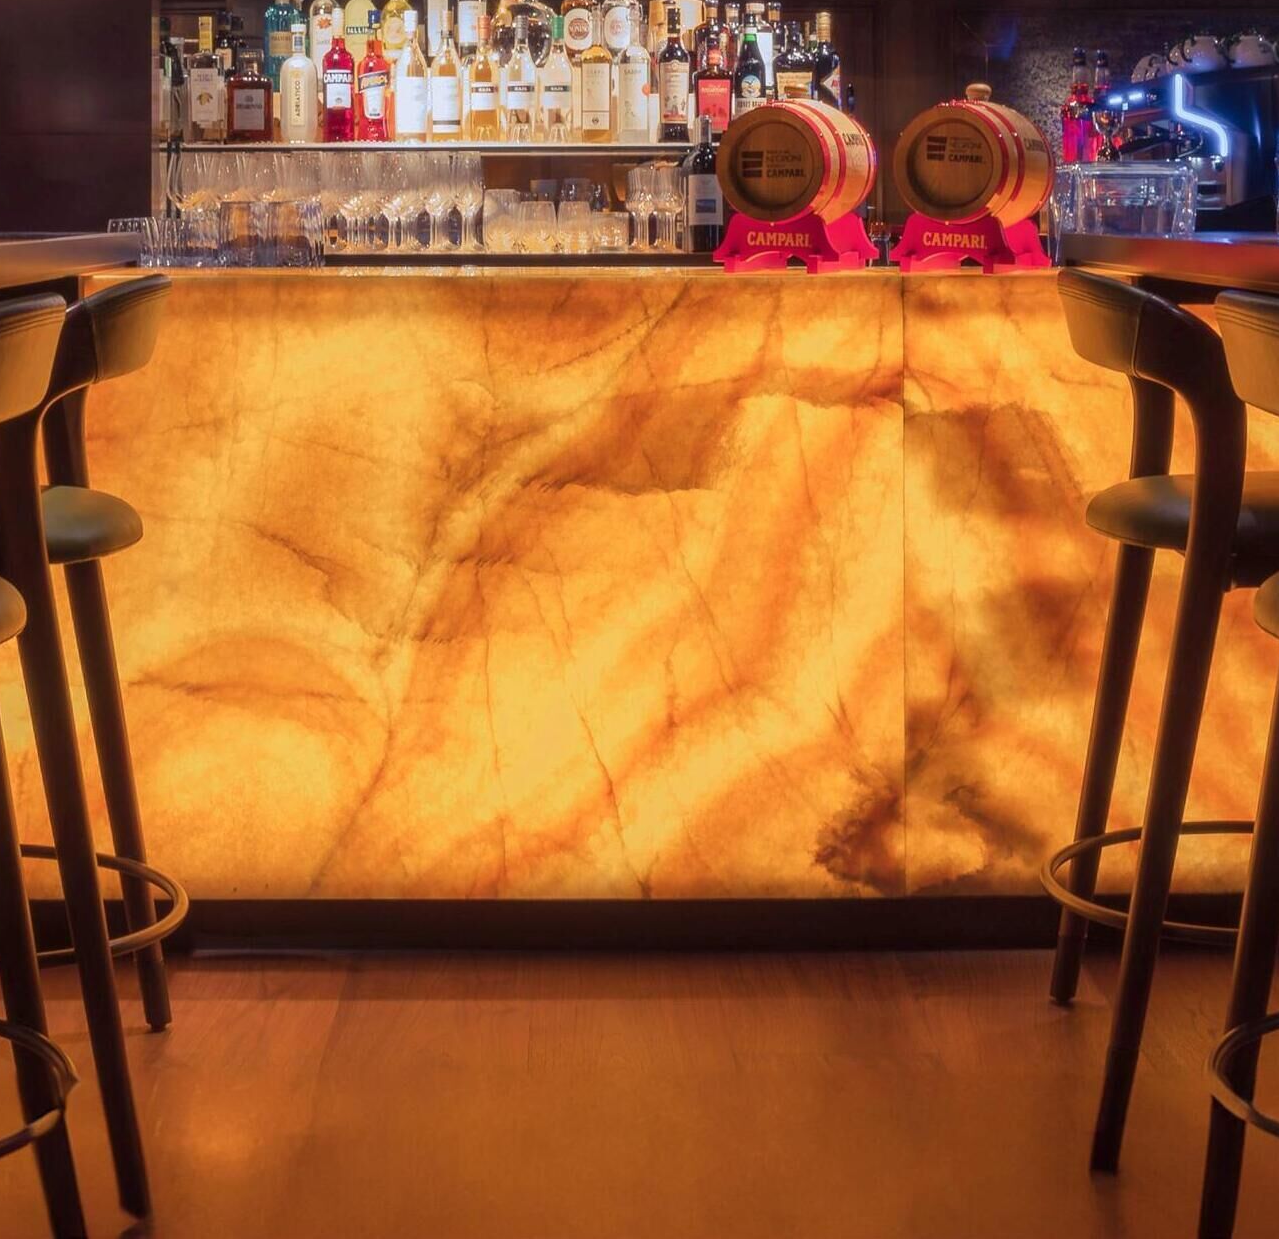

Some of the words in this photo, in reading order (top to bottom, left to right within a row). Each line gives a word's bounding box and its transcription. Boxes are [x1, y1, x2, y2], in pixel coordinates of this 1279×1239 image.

[948, 153, 986, 163] CAMPARI
[766, 168, 805, 178] CAMPARI
[747, 231, 812, 248] CAMPARI
[923, 231, 988, 250] CAMPARI
